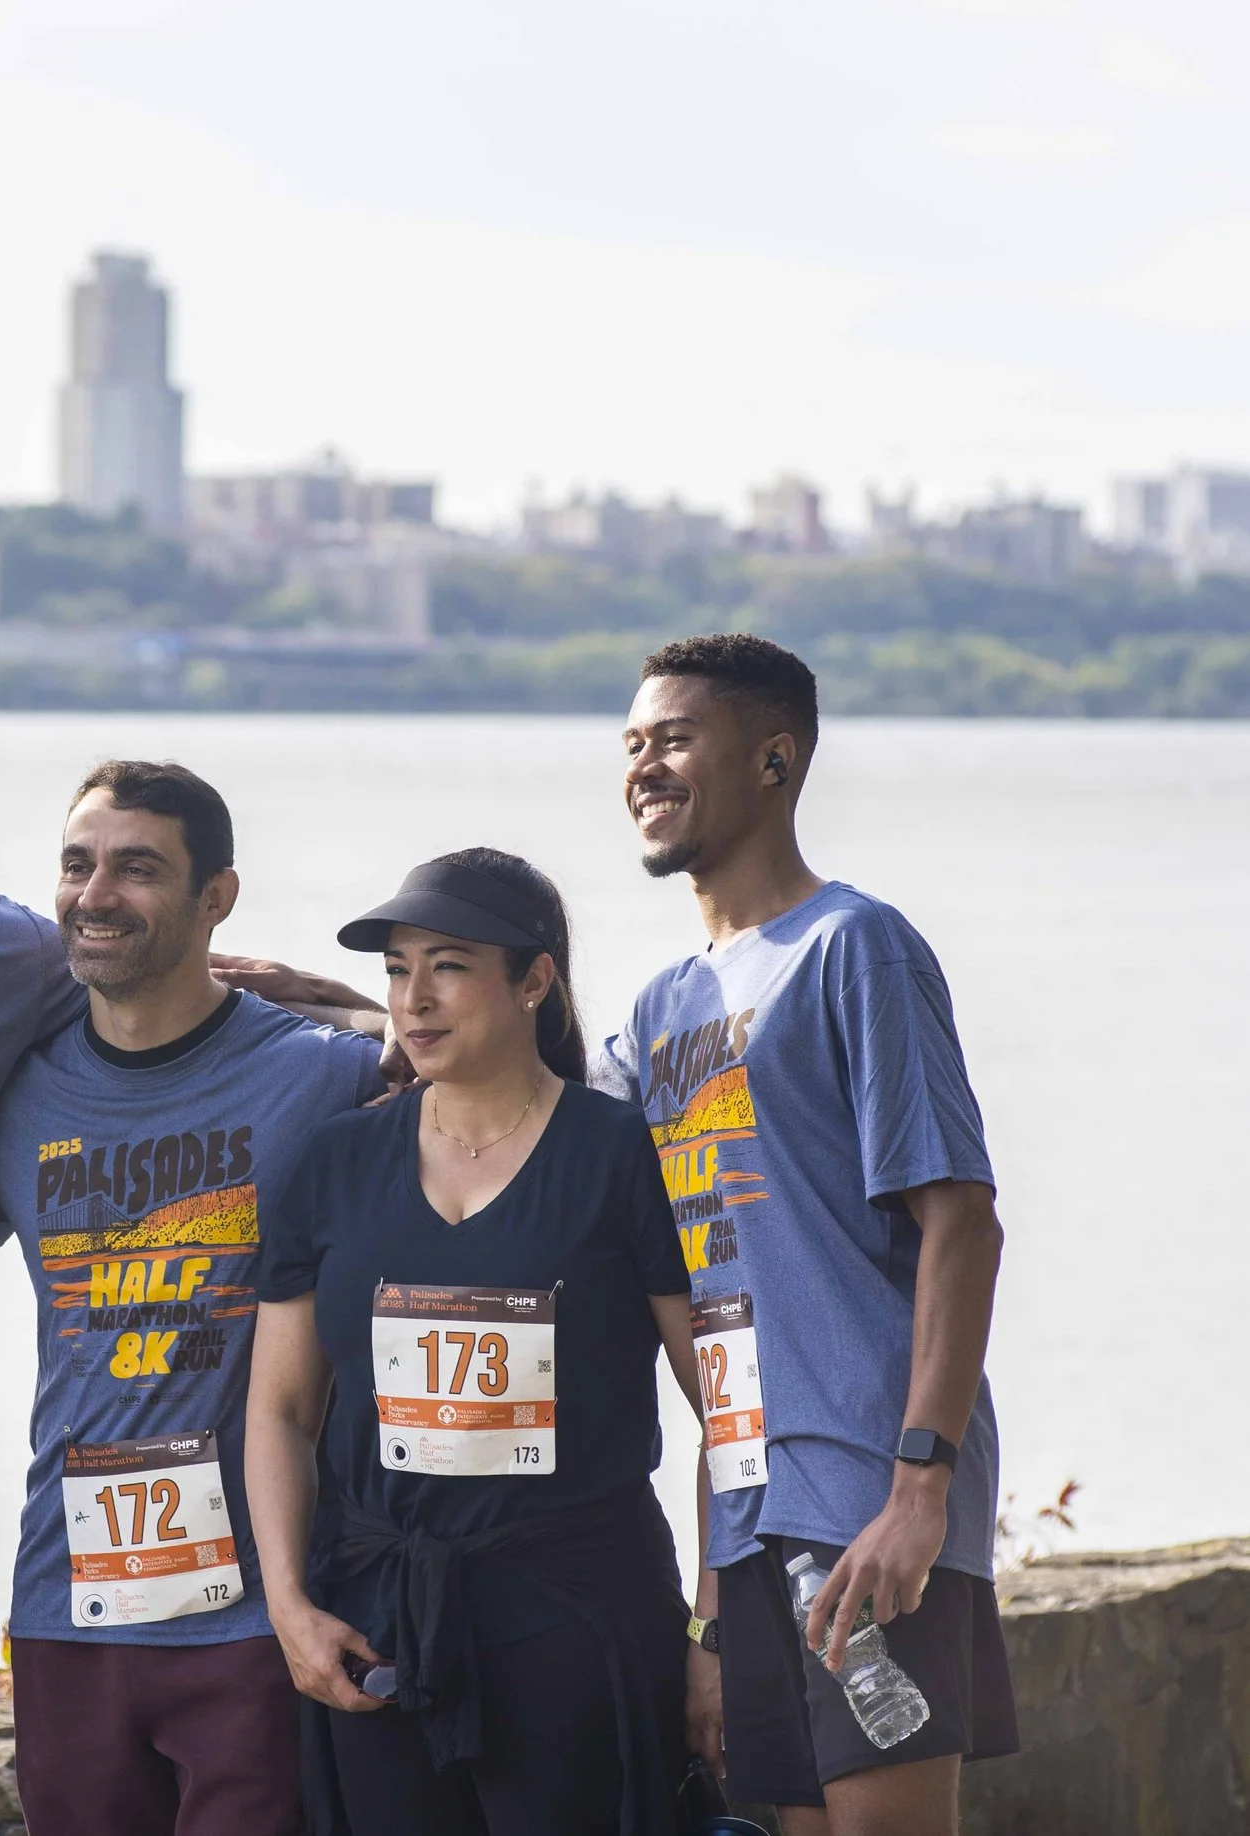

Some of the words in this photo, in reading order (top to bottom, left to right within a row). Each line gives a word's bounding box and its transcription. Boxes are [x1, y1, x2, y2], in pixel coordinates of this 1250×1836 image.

[38, 1137, 82, 1163] 2025
[37, 1125, 252, 1215] PALISADES
[710, 1217, 736, 1241] TRAIL
[709, 1236, 738, 1267] RUN
[89, 1257, 212, 1308] HALF
[380, 1300, 405, 1308] 2025
[410, 1290, 454, 1300] Palisades
[506, 1296, 537, 1307] CHPE
[409, 1301, 429, 1310] Half
[432, 1302, 478, 1312] Marathon
[87, 1303, 207, 1333] MARATHON
[177, 1329, 226, 1349] TRAIL
[109, 1331, 178, 1379] 8K
[173, 1347, 223, 1372] RUN
[388, 1356, 400, 1370] M
[417, 1330, 509, 1397] 173
[695, 1343, 731, 1412] 02
[387, 1405, 418, 1413] Palisades
[388, 1411, 406, 1419] Parks
[388, 1418, 429, 1427] Conservancy
[82, 1446, 118, 1457] Palisades
[170, 1439, 200, 1450] CHPE
[419, 1443, 453, 1451] Palisades
[83, 1459, 99, 1468] Half
[101, 1456, 144, 1467] Marathon
[420, 1457, 454, 1465] Marathon
[513, 1446, 540, 1464] 173
[739, 1458, 757, 1477] 102
[95, 1478, 188, 1547] 172
[203, 1584, 230, 1603] 172
